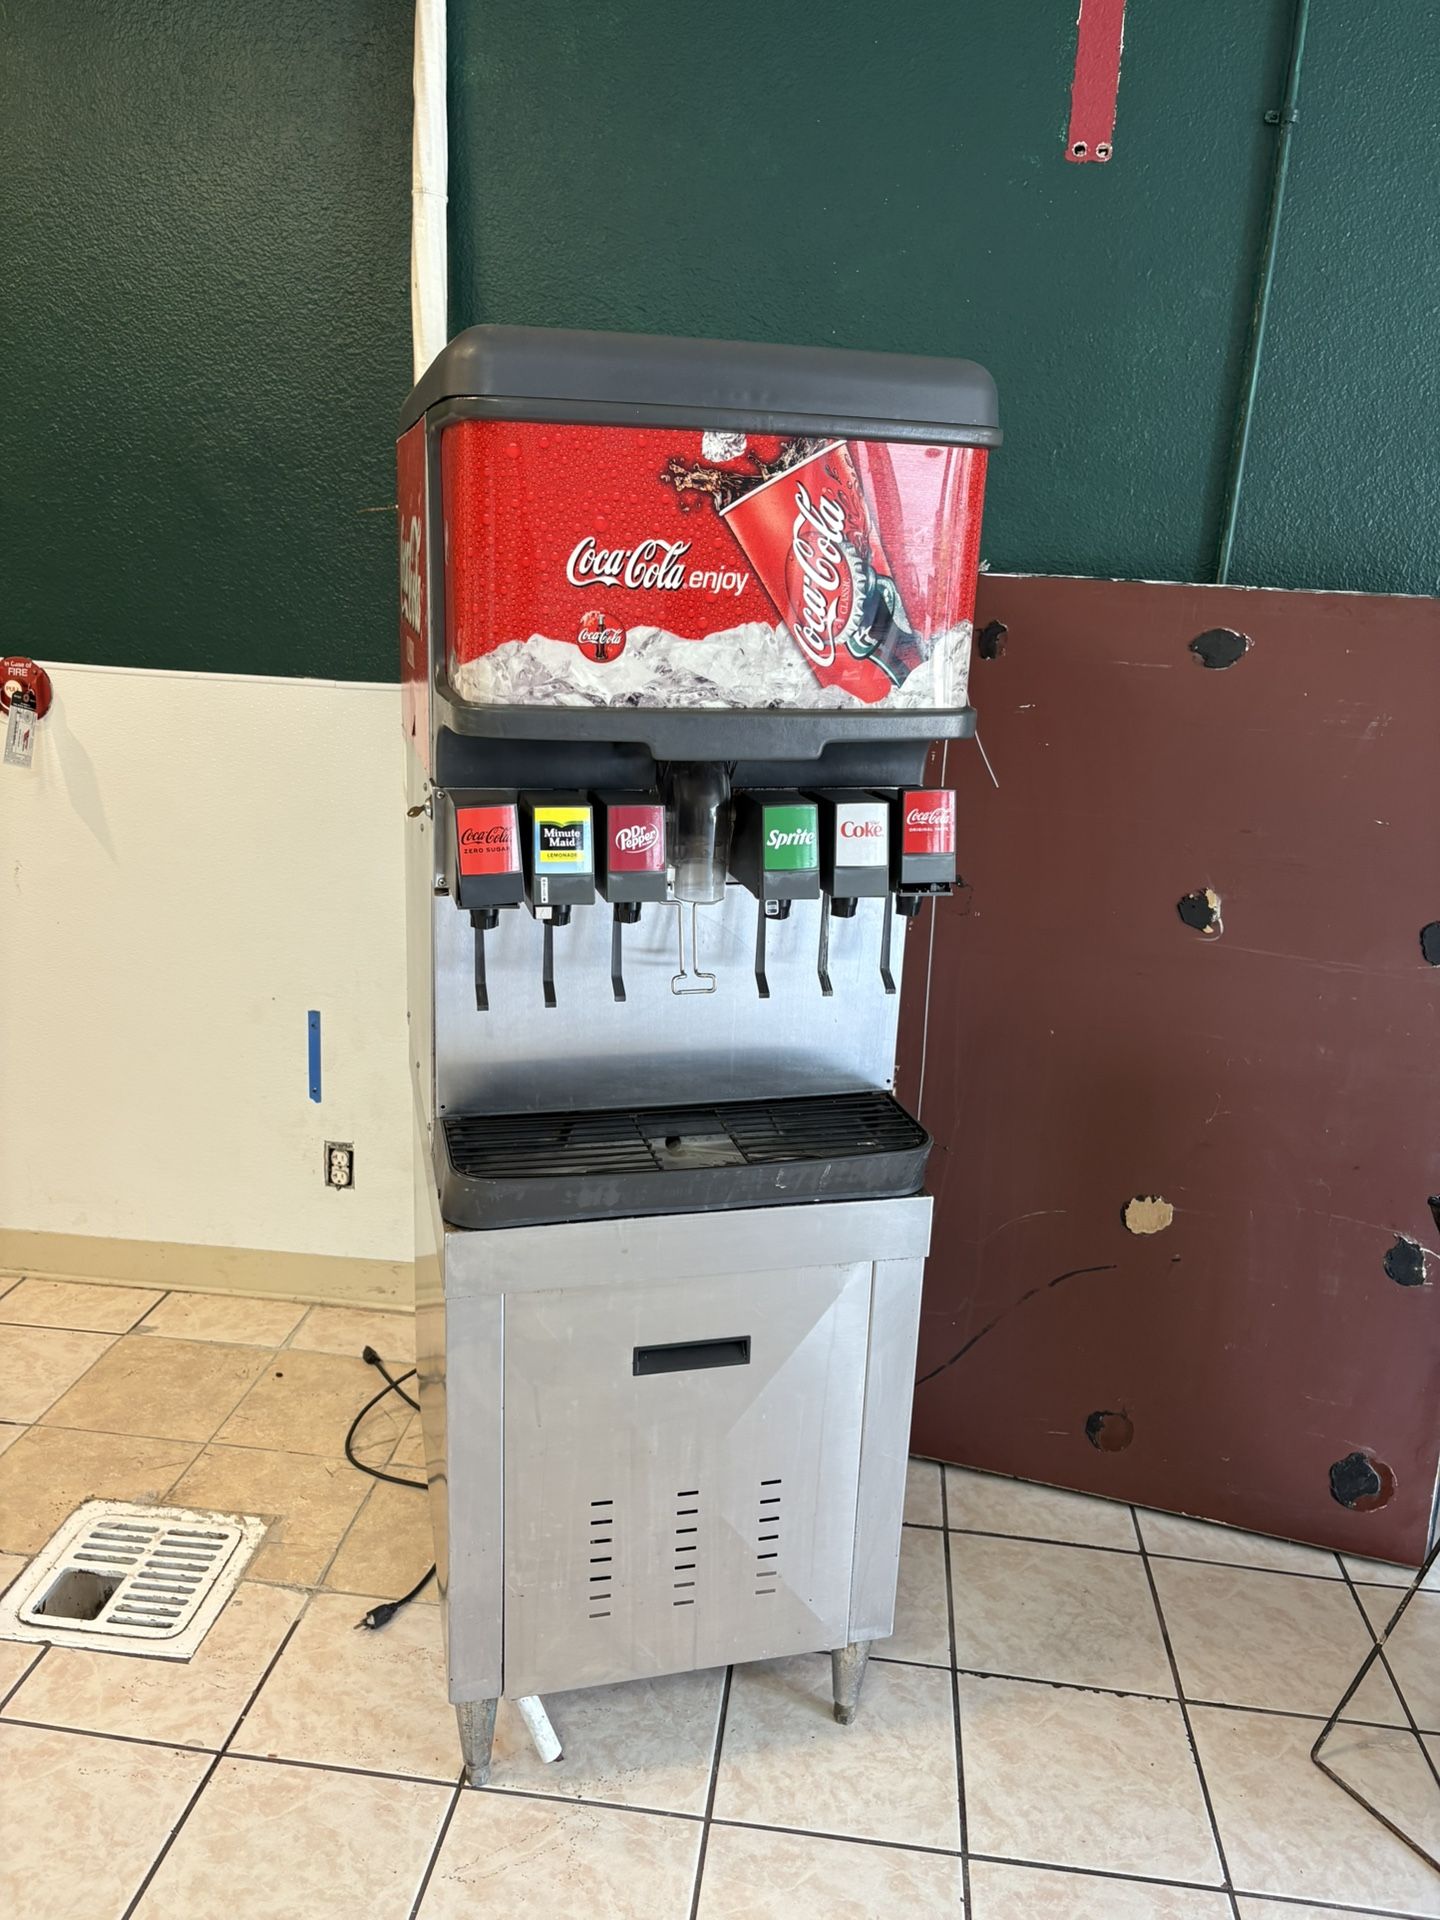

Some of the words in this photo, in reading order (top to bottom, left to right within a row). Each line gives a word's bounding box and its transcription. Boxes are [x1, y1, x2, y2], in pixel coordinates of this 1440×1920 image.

[566, 536, 692, 590] Coca-Cola
[689, 566, 749, 596] enjoy
[793, 480, 846, 667] Coca-Cola
[838, 577, 851, 616] CLASSIC
[578, 628, 624, 645] Coca-Cola
[8, 667, 28, 677] FIRE
[906, 807, 950, 825] Coca-Cola
[461, 826, 512, 845] Coca-Cola
[544, 828, 581, 838] Minute
[631, 825, 646, 837] Dr
[840, 820, 883, 838] Coke
[549, 837, 576, 847] Maid
[617, 828, 656, 851] Pepper
[766, 828, 816, 850] Sprite
